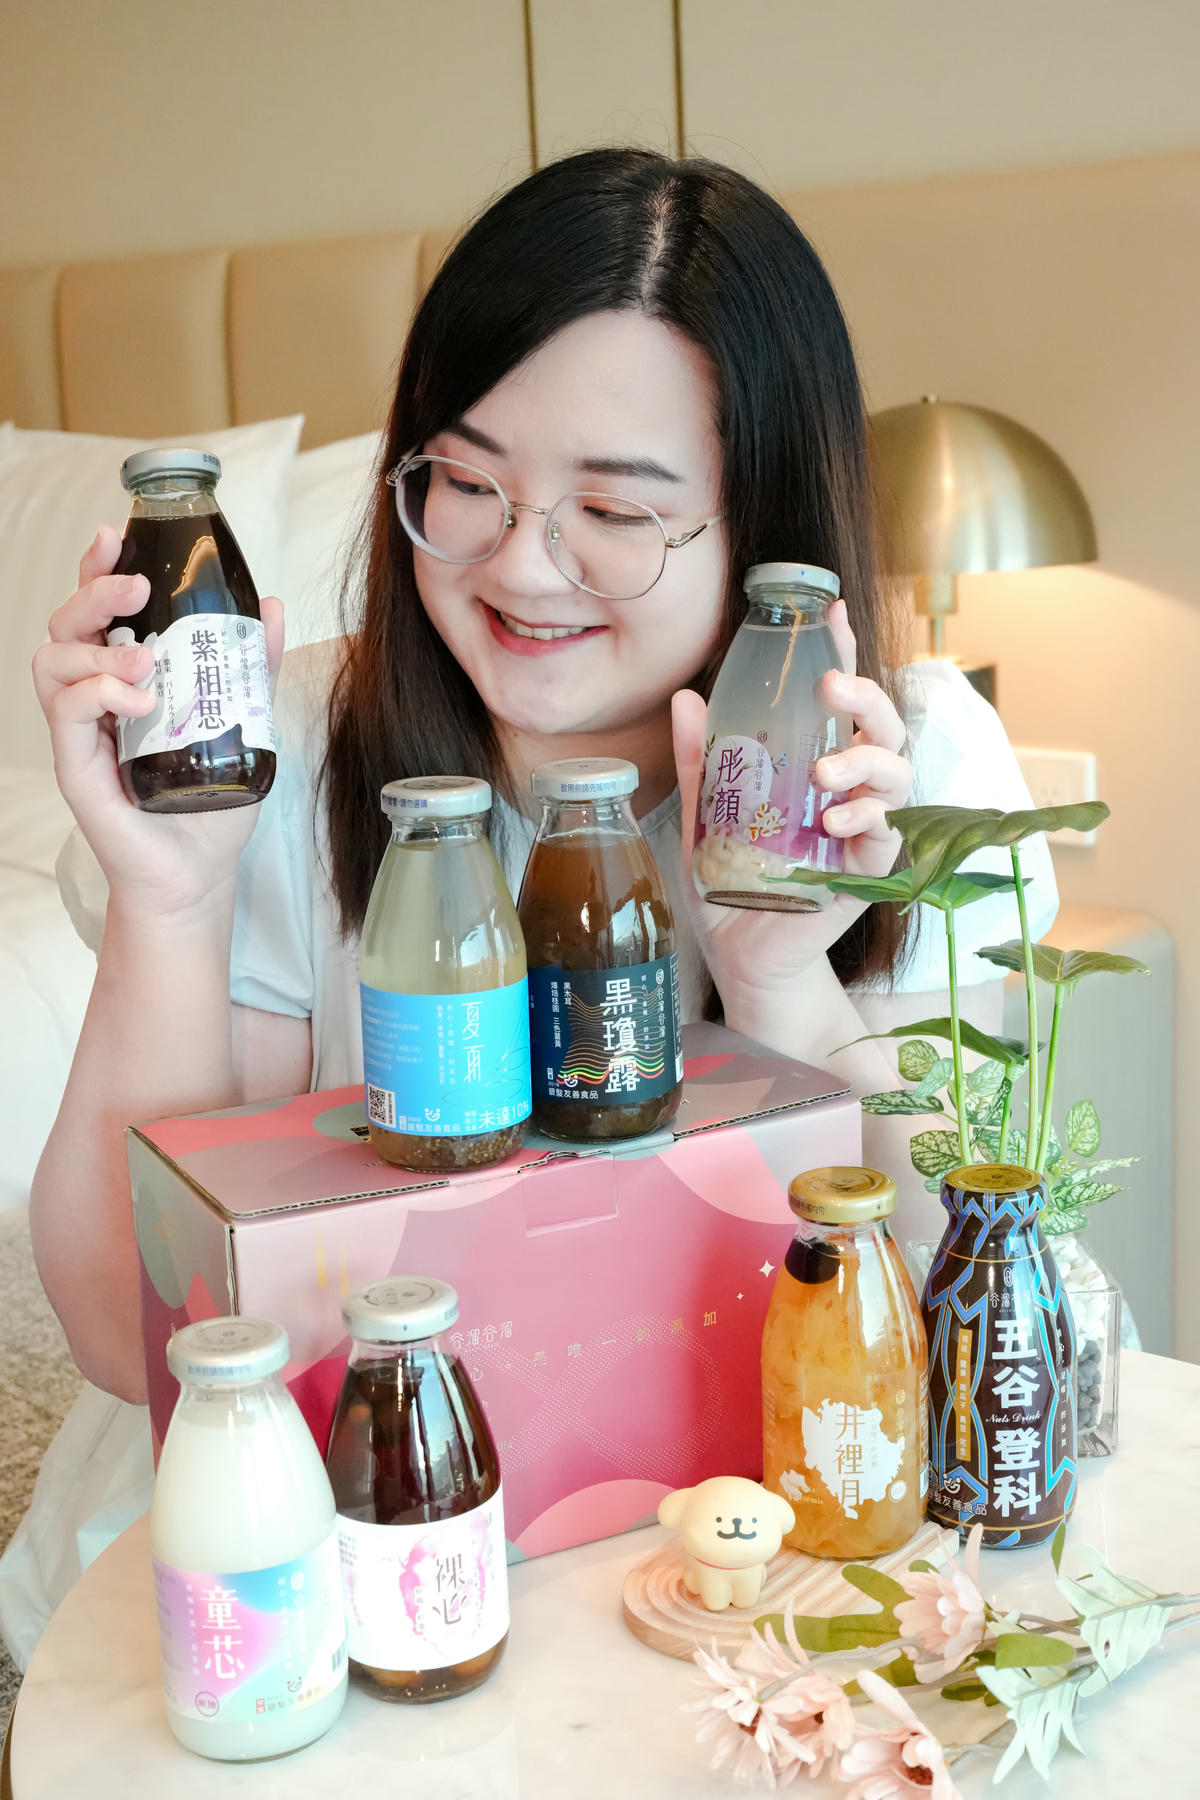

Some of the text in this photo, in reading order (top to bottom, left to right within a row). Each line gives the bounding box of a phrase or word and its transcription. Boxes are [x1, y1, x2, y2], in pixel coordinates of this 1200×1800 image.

[191, 630, 226, 730] 紫相思
[714, 746, 744, 825] 彤顏
[563, 981, 572, 1005] 黑木耳
[600, 978, 640, 1093] 黑瓊露
[833, 1405, 866, 1512] 井裡月
[985, 1410, 1041, 1424] Nuts Drink
[991, 1318, 1042, 1517] 五谷登科
[200, 1586, 245, 1679] 童芯
